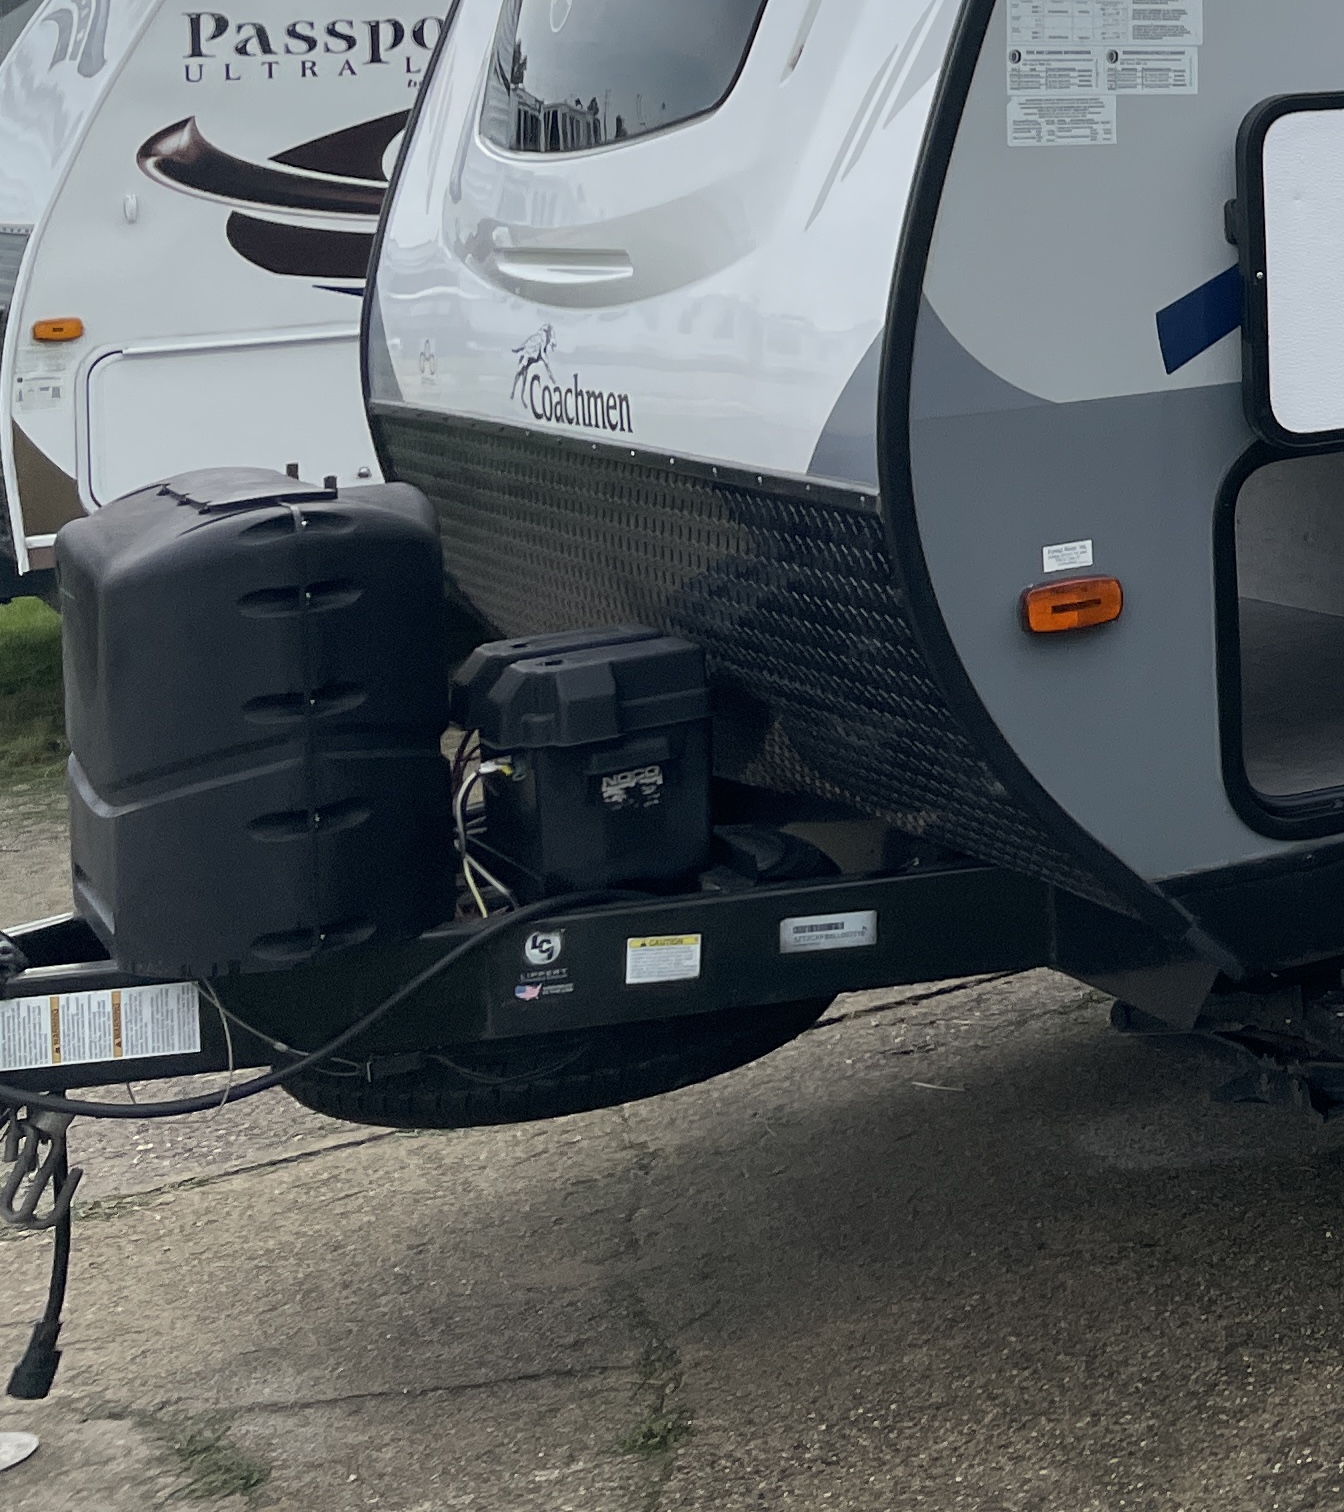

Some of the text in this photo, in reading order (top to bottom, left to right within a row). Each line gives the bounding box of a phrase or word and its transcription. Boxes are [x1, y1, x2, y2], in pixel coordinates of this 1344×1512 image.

[181, 11, 444, 65] Passpo
[184, 59, 358, 83] ULTRA
[529, 373, 633, 433] Coachmen
